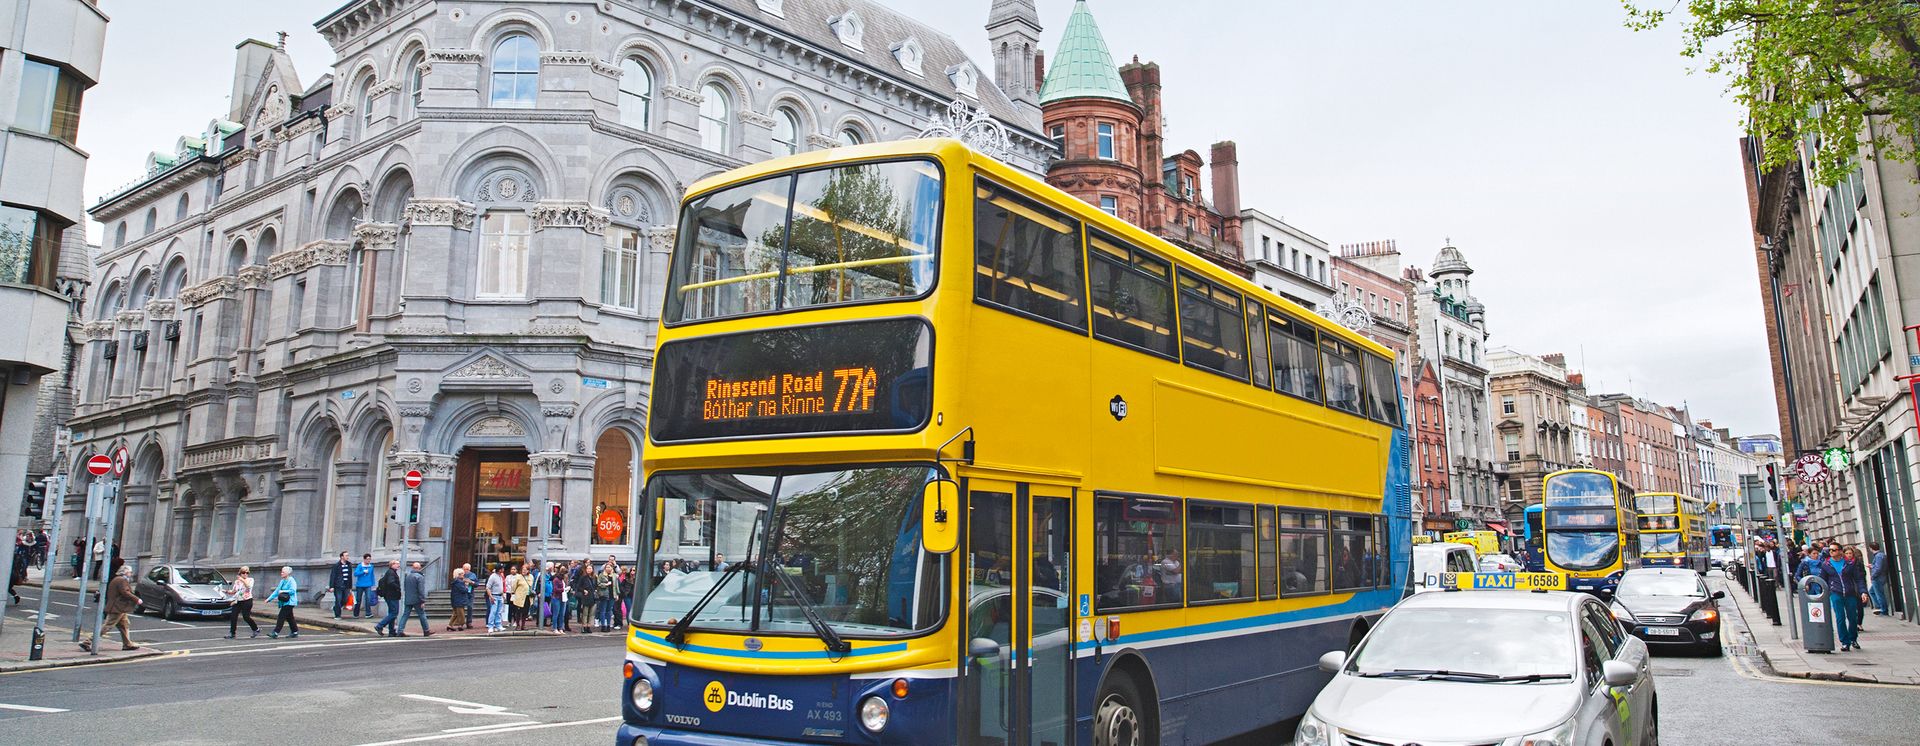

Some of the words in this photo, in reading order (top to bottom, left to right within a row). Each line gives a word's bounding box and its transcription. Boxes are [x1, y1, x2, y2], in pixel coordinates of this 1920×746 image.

[707, 375, 776, 398] Ringsend
[782, 371, 824, 395] Road
[833, 367, 877, 412] 77A
[704, 399, 753, 420] Bóthar
[758, 400, 776, 417] na
[781, 394, 825, 415] Rinne
[1800, 455, 1822, 465] COSTA
[1799, 471, 1828, 483] COFFEE
[599, 520, 621, 531] 50%
[1476, 574, 1513, 587] TAXI
[1527, 574, 1559, 587] 16588
[727, 690, 767, 709] Dublin
[768, 694, 794, 711] Bus
[665, 713, 701, 726] VOLVO
[807, 709, 821, 720] AX
[822, 710, 842, 721] 493
